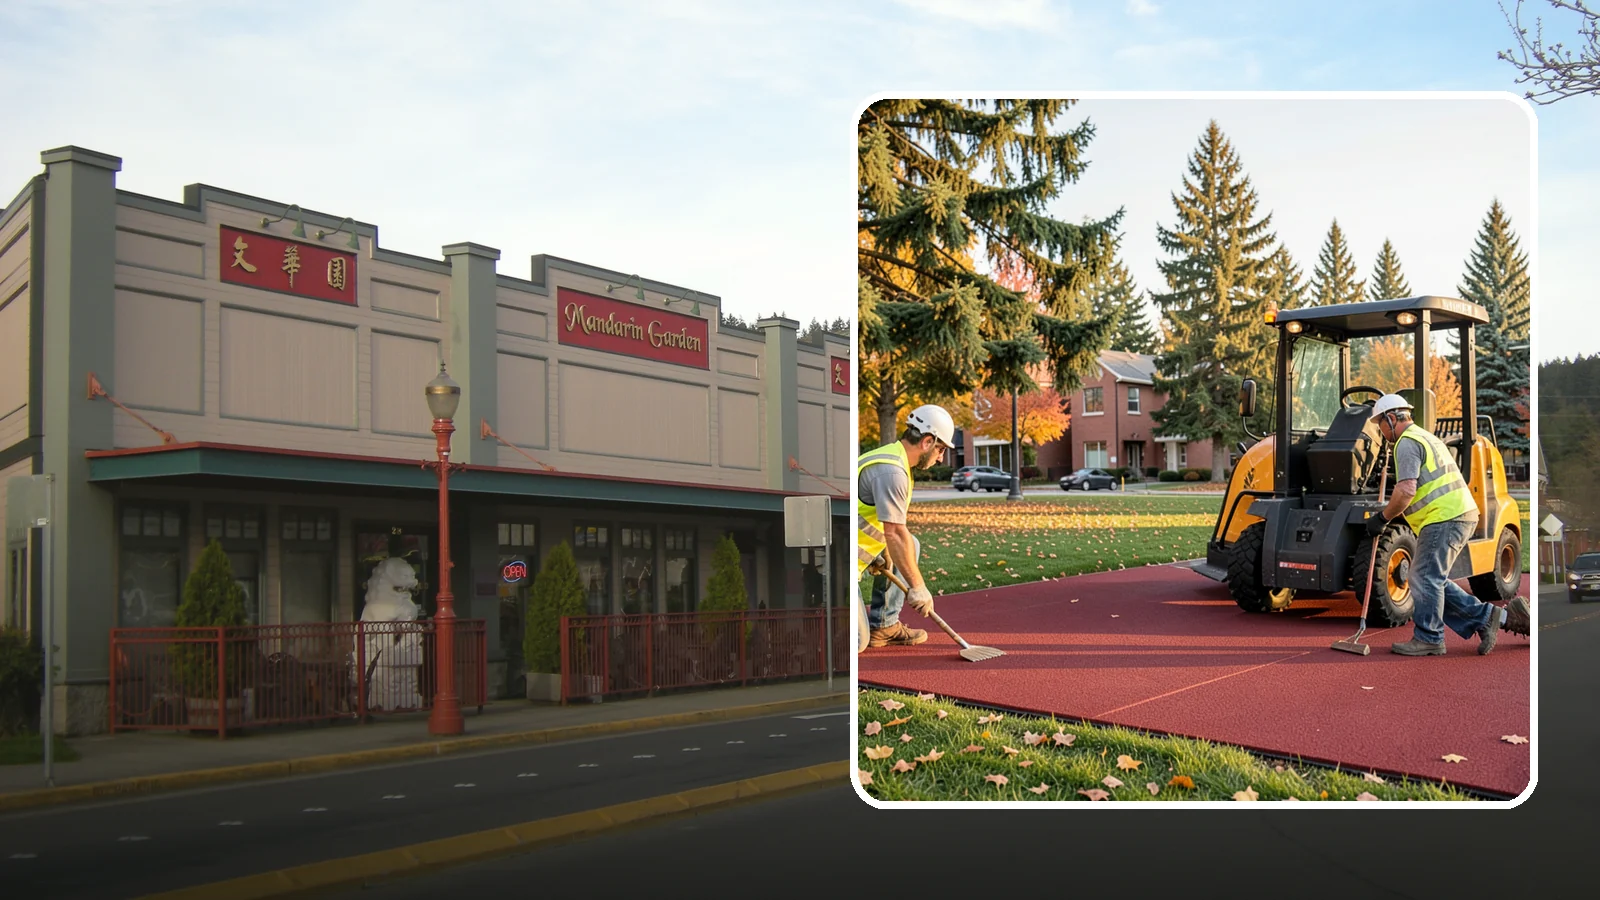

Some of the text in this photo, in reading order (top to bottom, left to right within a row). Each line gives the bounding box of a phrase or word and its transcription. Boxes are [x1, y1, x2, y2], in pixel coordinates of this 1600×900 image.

[230, 236, 346, 291] 文華園
[564, 302, 702, 352] Mandarin Garden
[503, 565, 527, 578] OPEN
